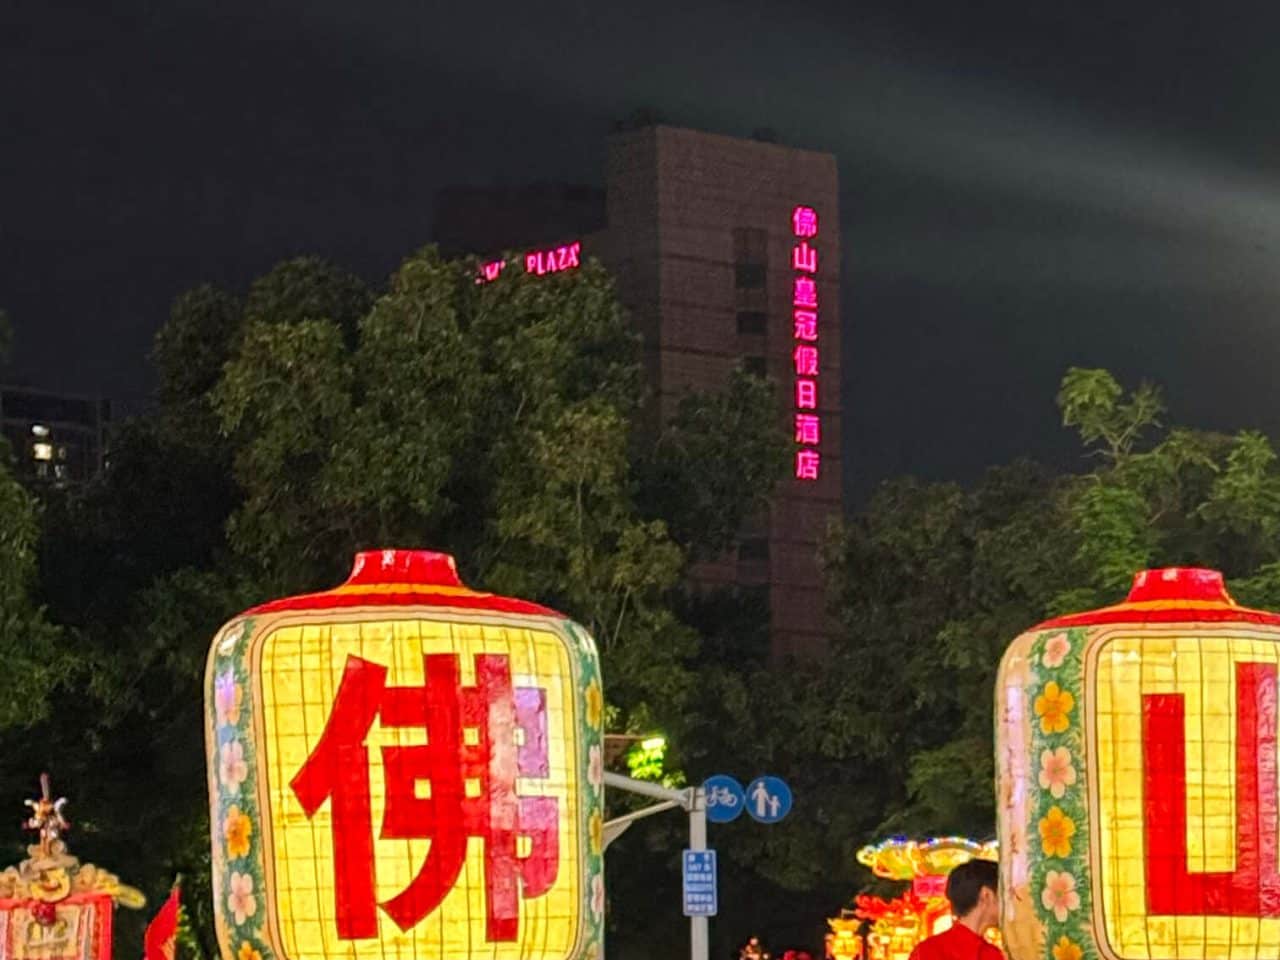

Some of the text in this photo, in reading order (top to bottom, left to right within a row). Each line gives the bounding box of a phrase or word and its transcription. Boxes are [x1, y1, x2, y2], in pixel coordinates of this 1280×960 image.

[794, 207, 819, 480] 佛山皇冠假日酒店
[290, 653, 560, 943] 佛
